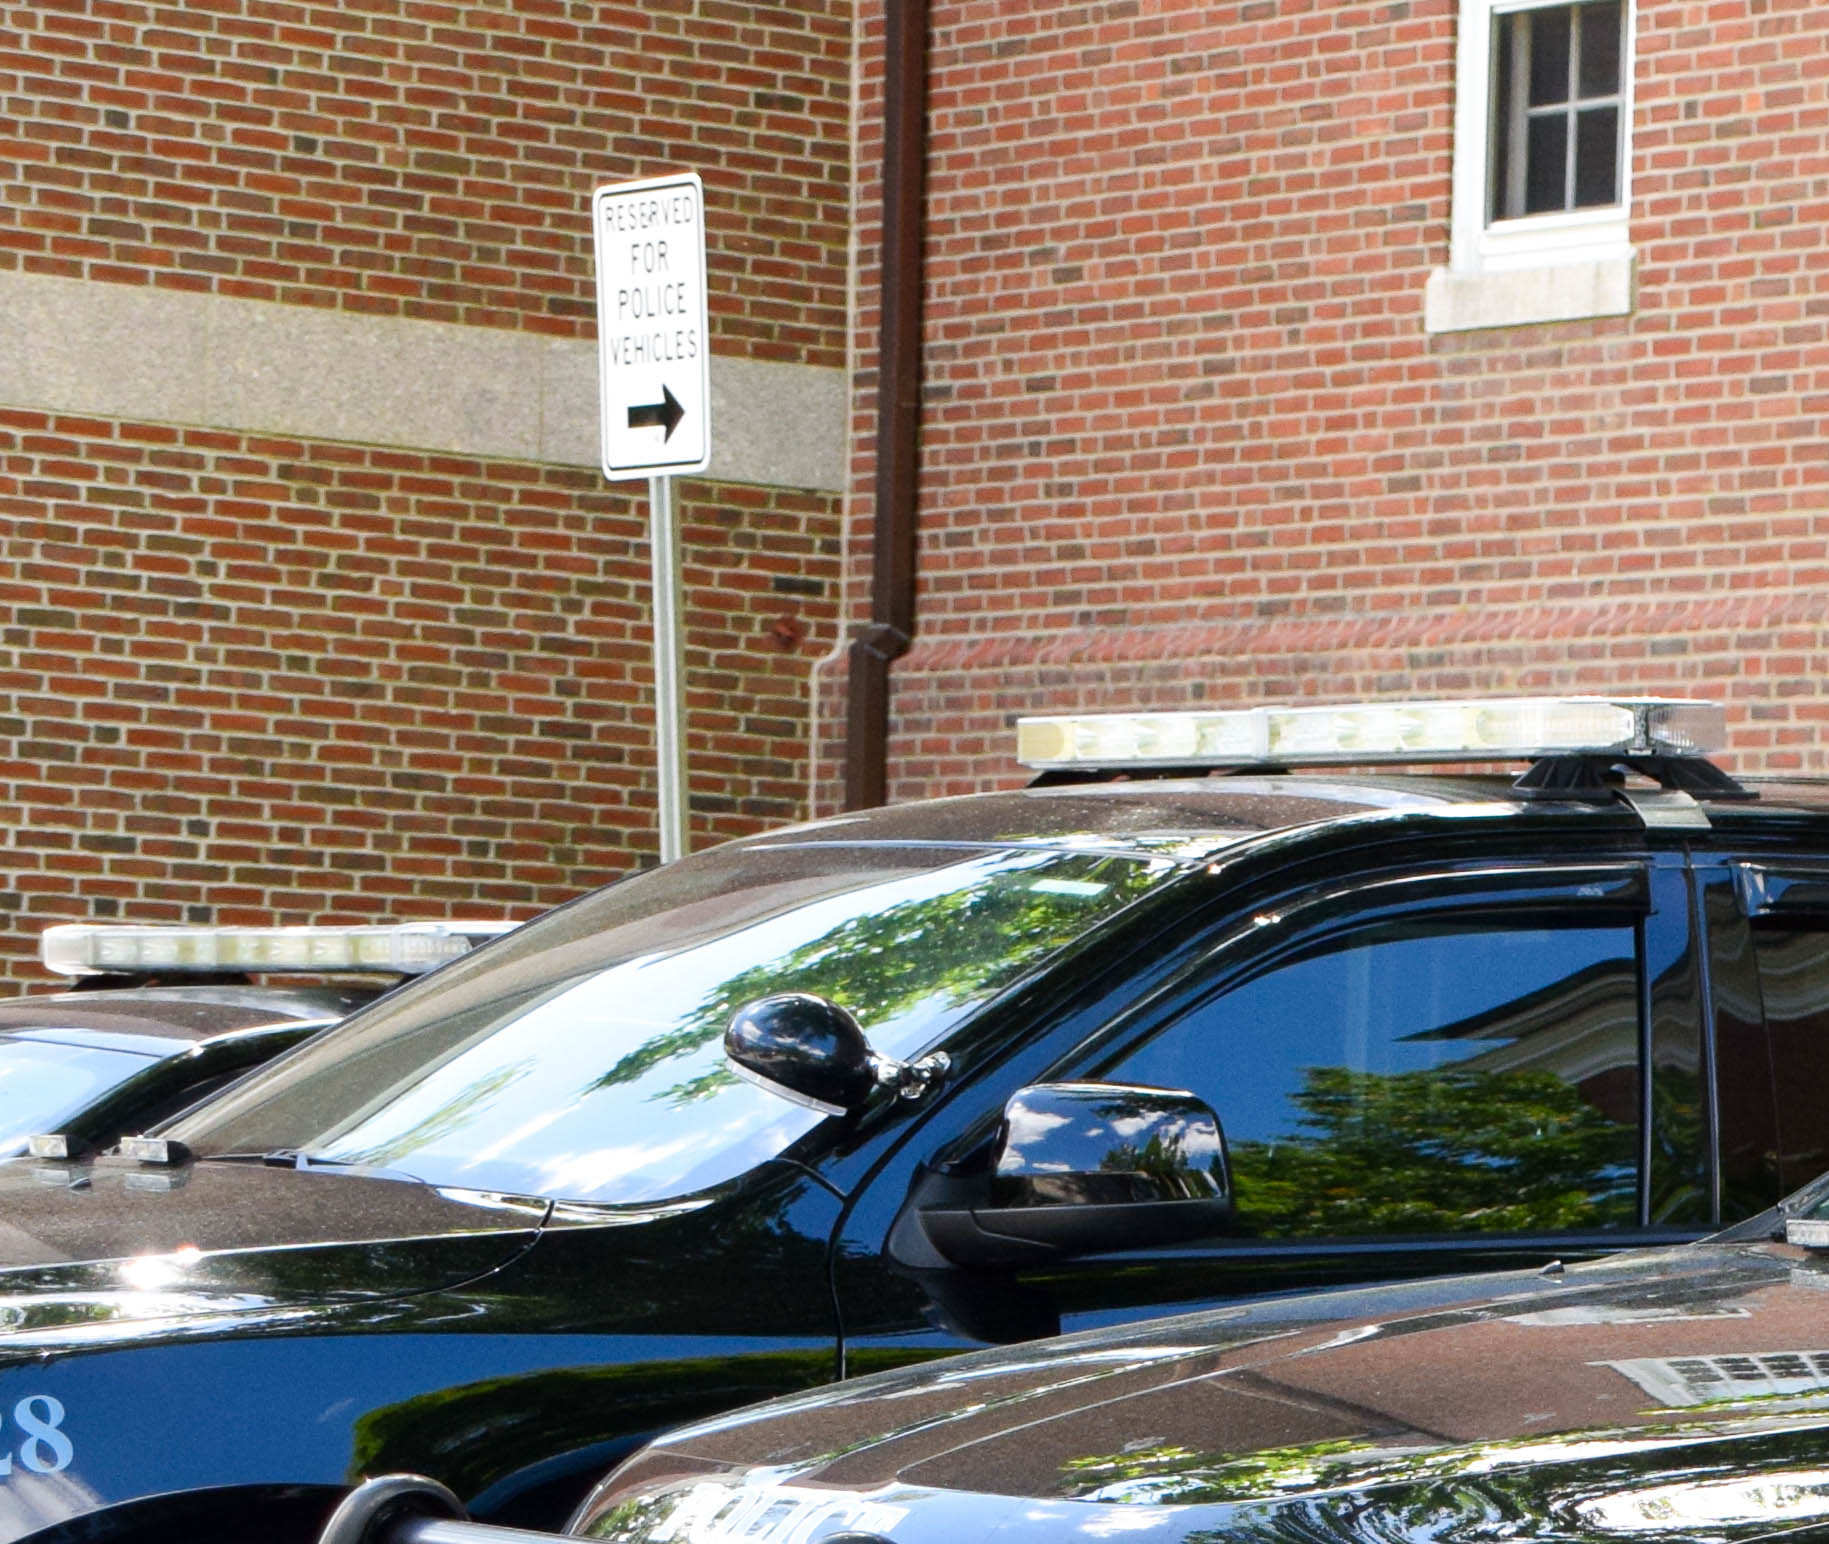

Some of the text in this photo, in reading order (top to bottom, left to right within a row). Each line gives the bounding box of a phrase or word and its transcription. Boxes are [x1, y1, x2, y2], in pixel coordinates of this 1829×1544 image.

[605, 196, 694, 232] RESERVED
[631, 240, 669, 275] FOR
[619, 282, 687, 321] POLICE
[611, 329, 698, 366] VEHICLES
